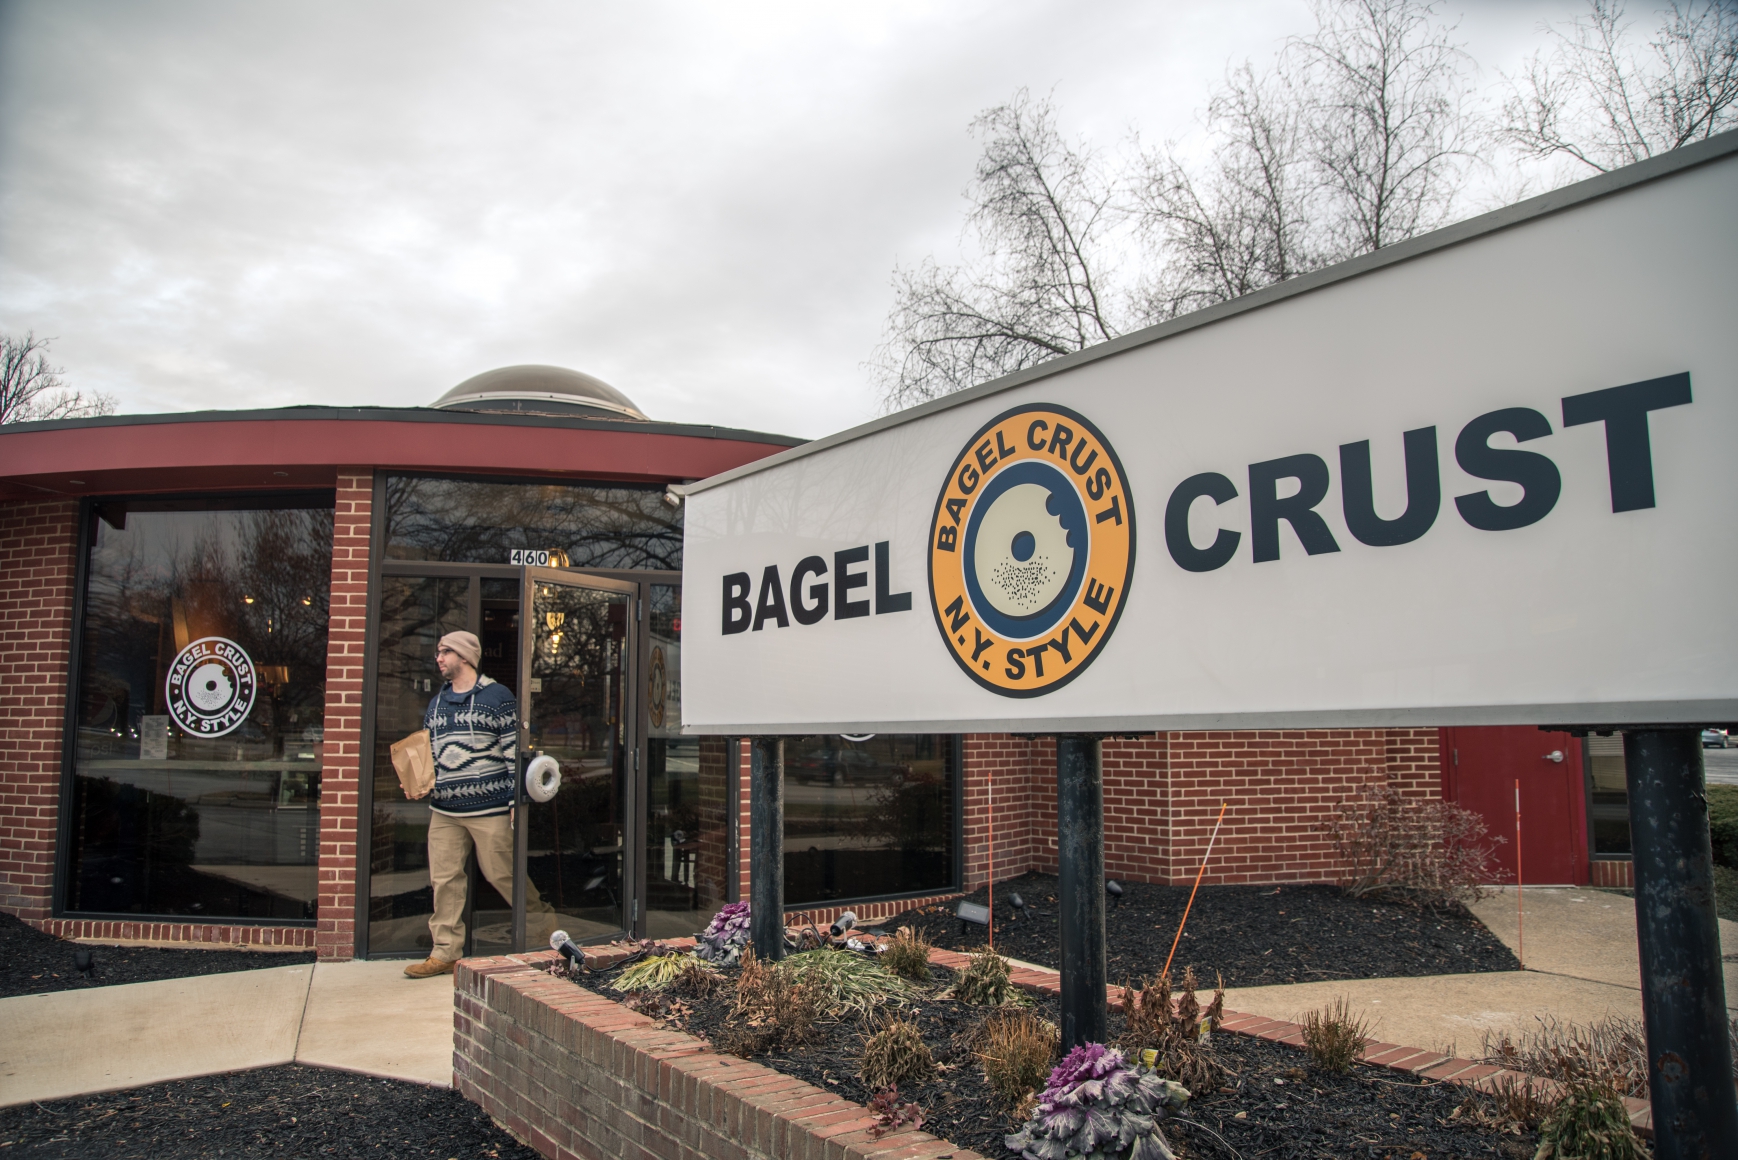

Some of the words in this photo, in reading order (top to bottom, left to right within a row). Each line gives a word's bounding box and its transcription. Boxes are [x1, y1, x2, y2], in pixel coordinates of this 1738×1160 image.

[722, 540, 912, 636] BAGEL
[1164, 371, 1693, 573] CRUST
[937, 430, 1016, 553] BAGEL
[1027, 419, 1122, 527] CRUST
[511, 550, 548, 565] 460
[944, 595, 994, 671] N.Y.
[1004, 577, 1114, 680] STYLE
[171, 644, 211, 685] BAGEL
[215, 643, 252, 685] CRUST
[173, 699, 197, 728] N.Y.
[201, 698, 247, 732] STYLE
[90, 741, 113, 758] psi
